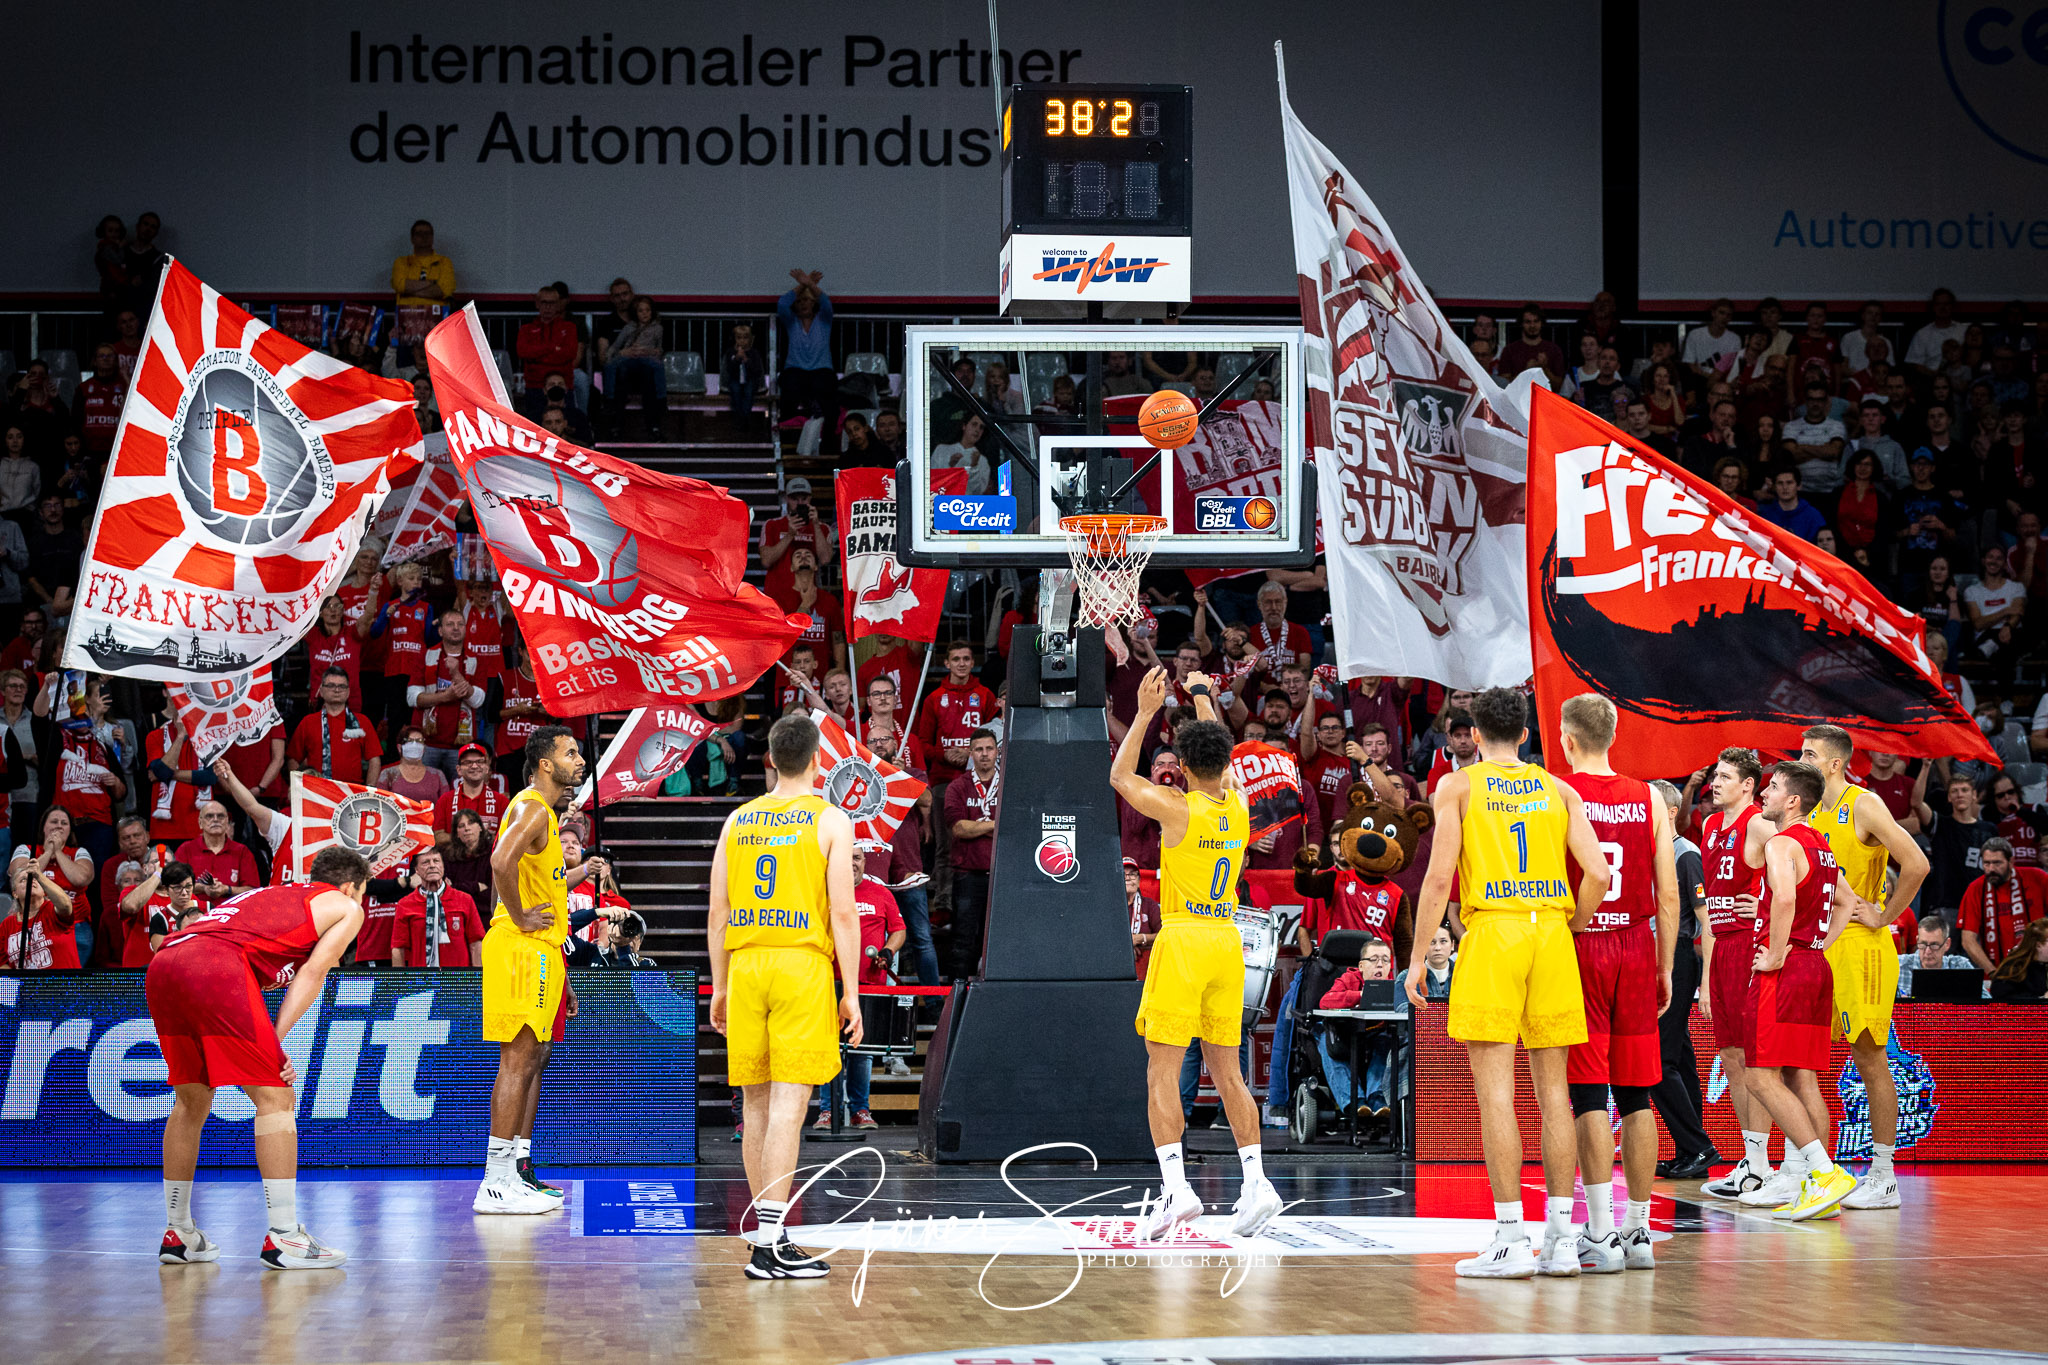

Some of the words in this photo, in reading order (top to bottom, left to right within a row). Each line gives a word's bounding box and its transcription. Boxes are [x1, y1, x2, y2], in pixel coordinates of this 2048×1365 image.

[349, 31, 823, 88] Internationaler
[843, 35, 1082, 88] Partner
[349, 111, 458, 163] der
[476, 112, 1001, 167] Automobilindus
[1042, 248, 1077, 257] welcome
[1079, 248, 1088, 257] to
[1042, 256, 1159, 283] WOW
[167, 394, 189, 463] FANCLUB
[188, 350, 243, 392] FASZINATION
[245, 357, 311, 431] BASKETBALL
[308, 435, 337, 500] BAMBERG
[197, 408, 254, 432] TRIPLE
[210, 402, 271, 521] B
[853, 502, 897, 516] BASKE
[960, 512, 1012, 527] Credit
[1211, 505, 1236, 514] Credit
[1202, 514, 1236, 528] BBL
[501, 568, 690, 645] BAMBERG
[393, 640, 422, 651] brose
[556, 673, 579, 697] at
[588, 664, 619, 689] its
[636, 655, 738, 697] BEST!
[655, 709, 705, 737] FANC
[962, 710, 982, 729] 43
[941, 735, 971, 748] bros
[1486, 796, 1549, 814] interzero
[357, 809, 384, 848] B
[735, 809, 816, 827] MATTISSECK
[1042, 812, 1076, 823] brose
[1042, 823, 1076, 831] bamberg
[737, 831, 799, 847] interzero
[1509, 821, 1528, 874] 1
[754, 854, 777, 900] 9
[1210, 856, 1231, 901] 0
[1716, 855, 1735, 880] 33
[1485, 880, 1519, 900] ALBA
[1519, 879, 1568, 899] BERLIN
[728, 908, 755, 927] ALBA
[758, 908, 809, 930] BERLIN
[1365, 906, 1387, 928] 99
[536, 951, 548, 1009] interzero
